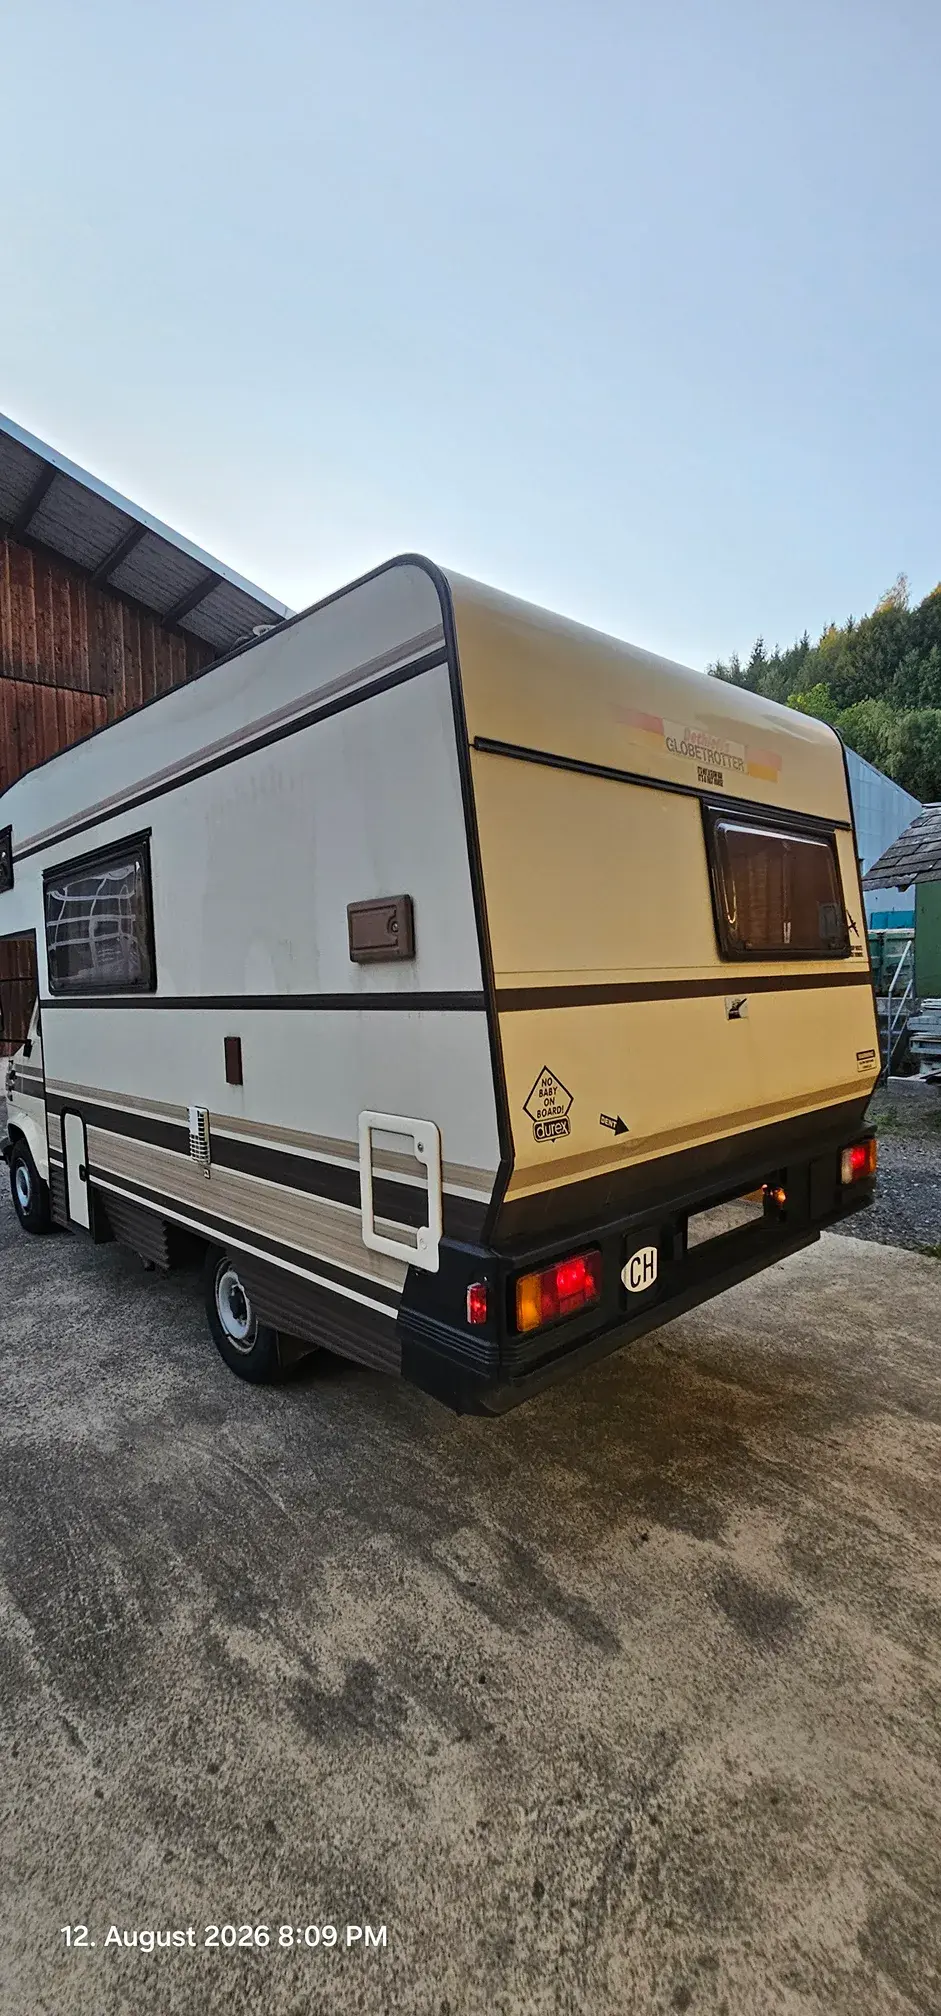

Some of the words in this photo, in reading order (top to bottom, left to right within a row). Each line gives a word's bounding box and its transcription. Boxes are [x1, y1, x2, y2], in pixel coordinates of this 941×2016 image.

[665, 736, 745, 772] GLOBETROTTER
[541, 1077, 553, 1087] NO
[538, 1086, 558, 1098] BABY
[543, 1097, 555, 1107] ON
[536, 1105, 564, 1119] BOARD!
[536, 1121, 569, 1139] durex
[630, 1250, 654, 1288] CH
